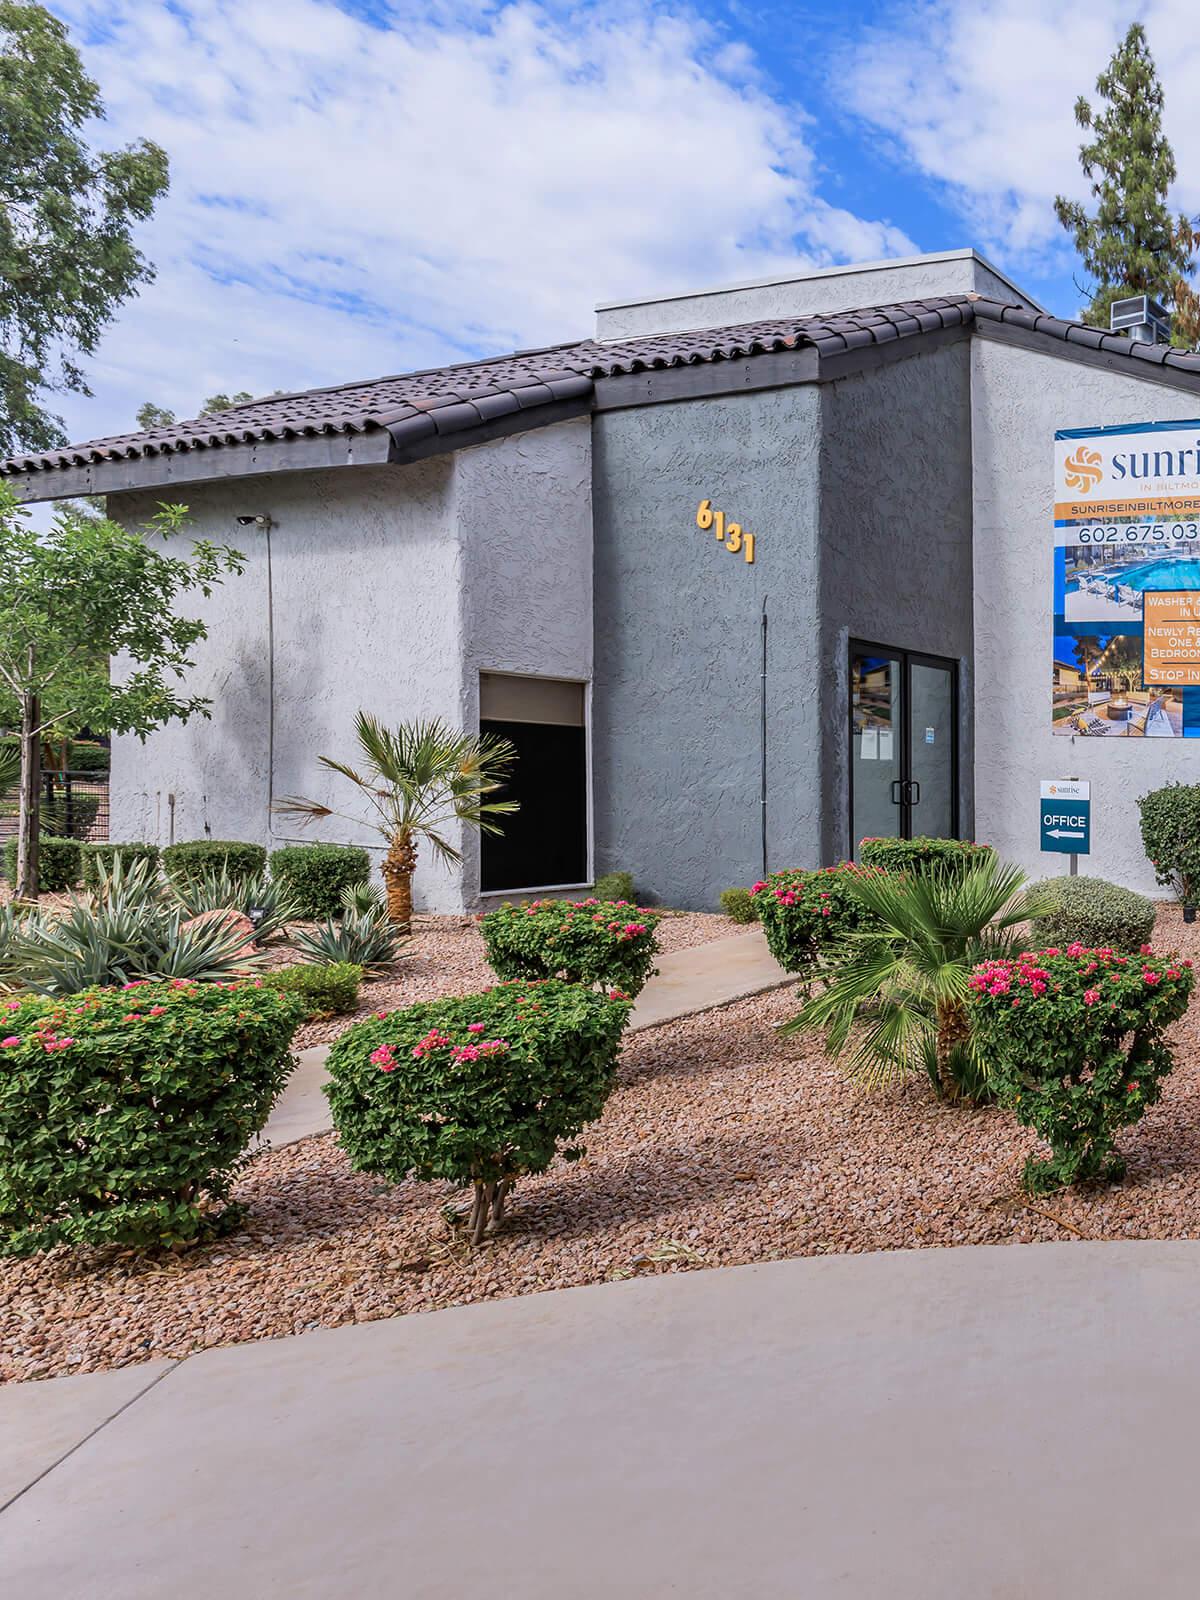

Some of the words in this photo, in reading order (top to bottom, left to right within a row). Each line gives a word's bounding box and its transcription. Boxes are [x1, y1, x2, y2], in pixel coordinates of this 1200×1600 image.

[1140, 484, 1152, 492] IN
[696, 499, 755, 564] 6131
[1148, 597, 1193, 606] WASHER
[1180, 608, 1191, 617] IN
[1148, 627, 1185, 637] NEWLY
[1168, 637, 1193, 647] ONE
[1149, 669, 1184, 680] STOP
[1187, 669, 1200, 680] IN
[1043, 814, 1087, 827] OFFICE
